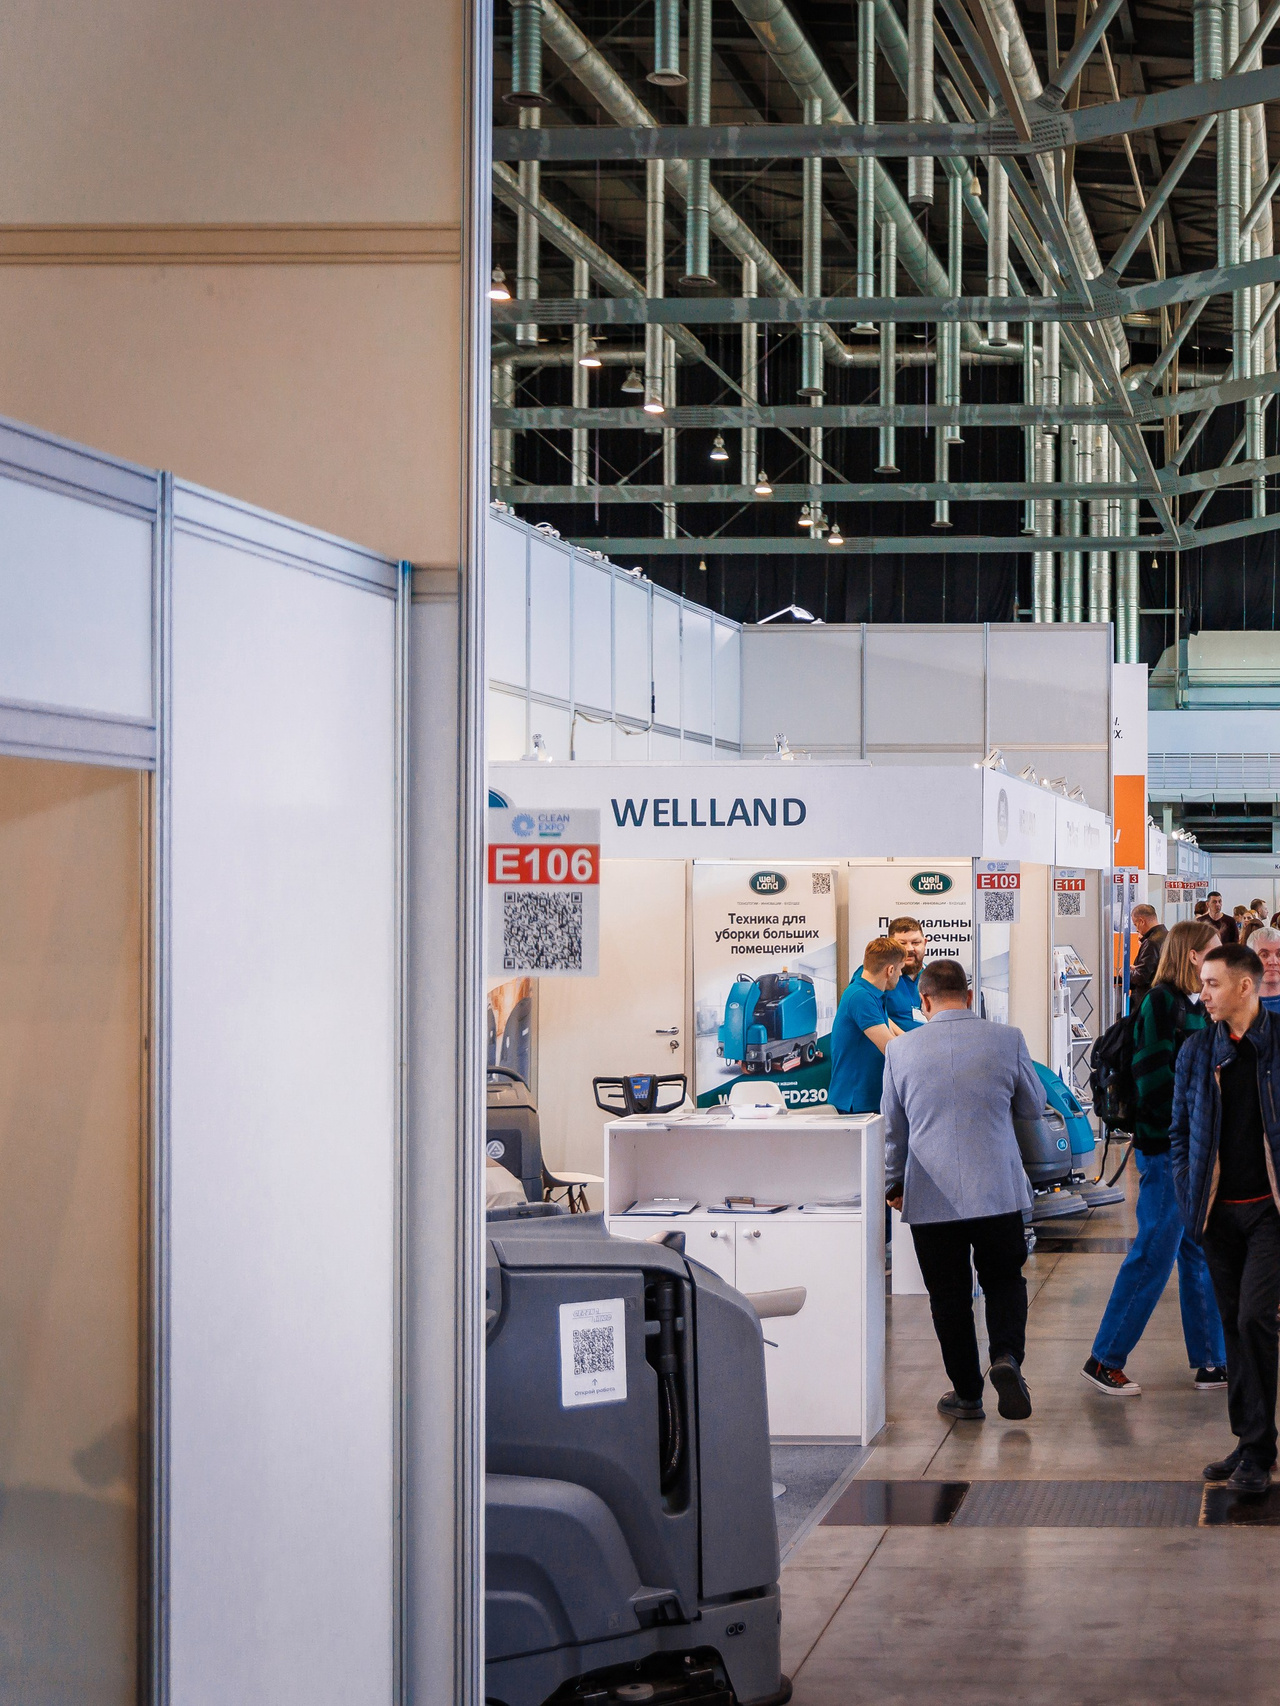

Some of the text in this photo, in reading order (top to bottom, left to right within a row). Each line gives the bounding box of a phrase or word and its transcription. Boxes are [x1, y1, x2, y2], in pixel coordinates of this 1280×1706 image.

[610, 798, 807, 826] WELLLAND
[538, 814, 571, 822] CLEAN
[538, 823, 566, 832] EXPO
[495, 848, 593, 881] E106
[920, 875, 940, 884] well
[981, 875, 1018, 888] E109
[1055, 880, 1082, 890] E111
[756, 881, 779, 890] Land
[918, 882, 943, 890] Land
[728, 913, 806, 925] Техника для
[715, 928, 819, 942] уборки больших
[731, 942, 804, 955] помещений
